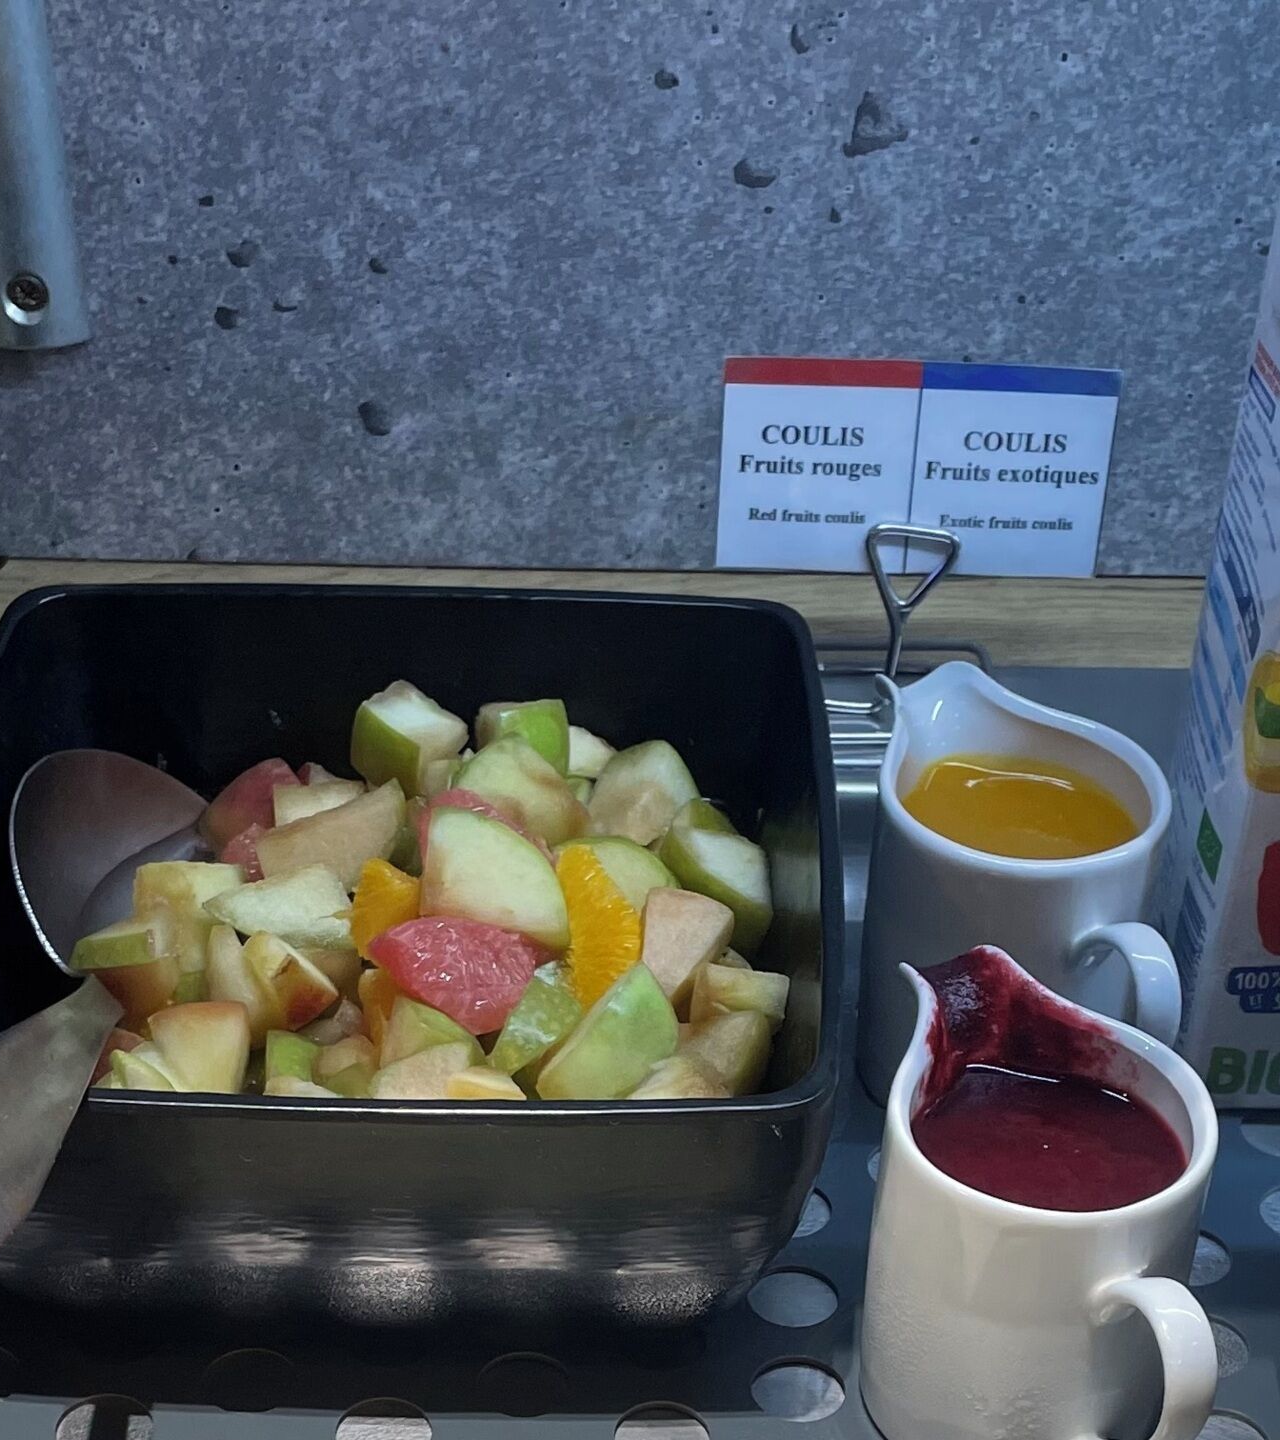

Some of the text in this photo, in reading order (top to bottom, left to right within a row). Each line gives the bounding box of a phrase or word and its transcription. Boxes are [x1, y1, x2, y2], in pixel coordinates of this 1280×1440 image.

[761, 424, 865, 447] COULIS
[963, 430, 1068, 453] COULIS
[738, 454, 882, 481] Fruits rouges
[924, 460, 1100, 488] Fruits exotiques
[748, 507, 866, 524] Red fruits coulis
[939, 513, 1073, 531] Exotic fruits coulis
